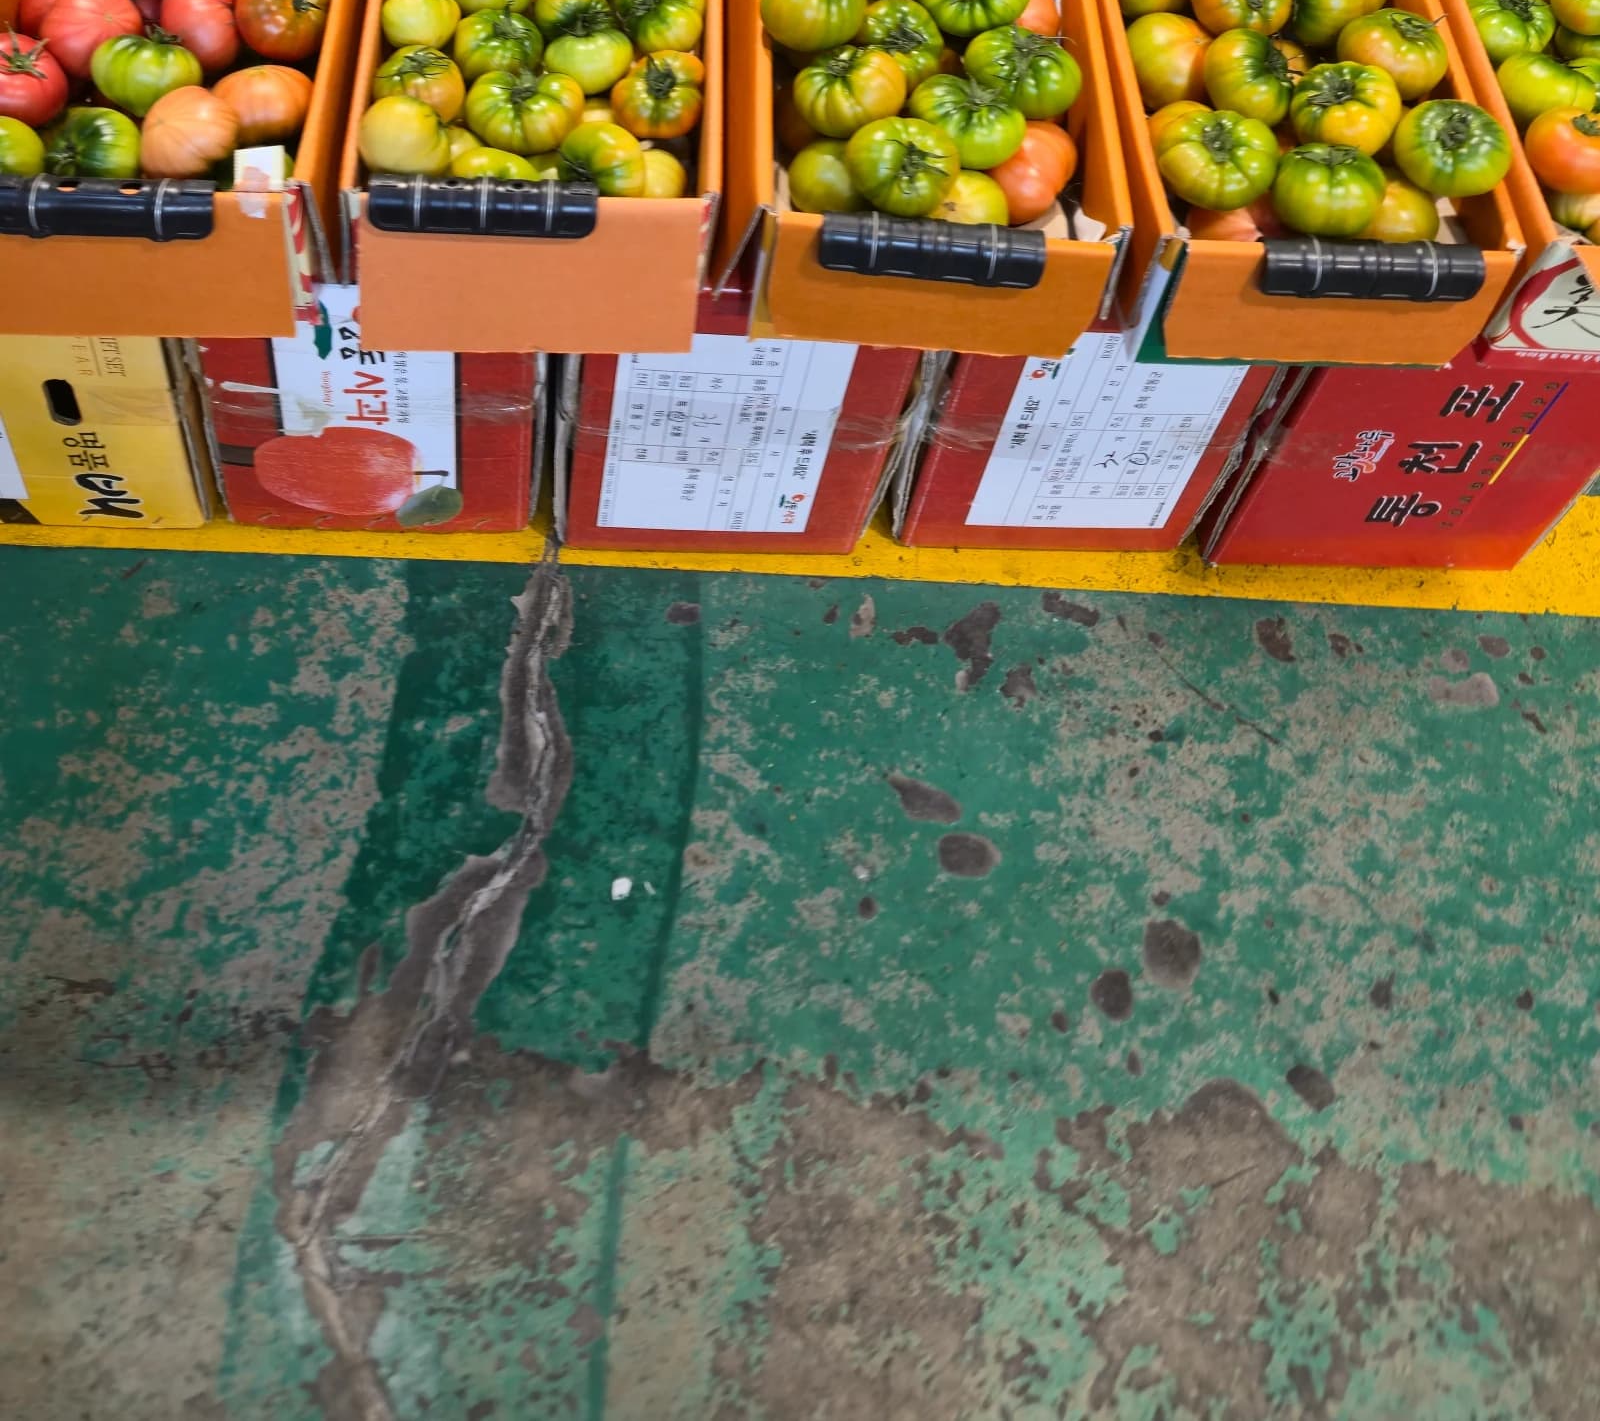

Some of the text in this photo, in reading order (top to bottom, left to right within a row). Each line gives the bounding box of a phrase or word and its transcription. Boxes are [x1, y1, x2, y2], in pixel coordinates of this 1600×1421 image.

[71, 336, 94, 377] EAR
[62, 431, 146, 519] 명품 배
